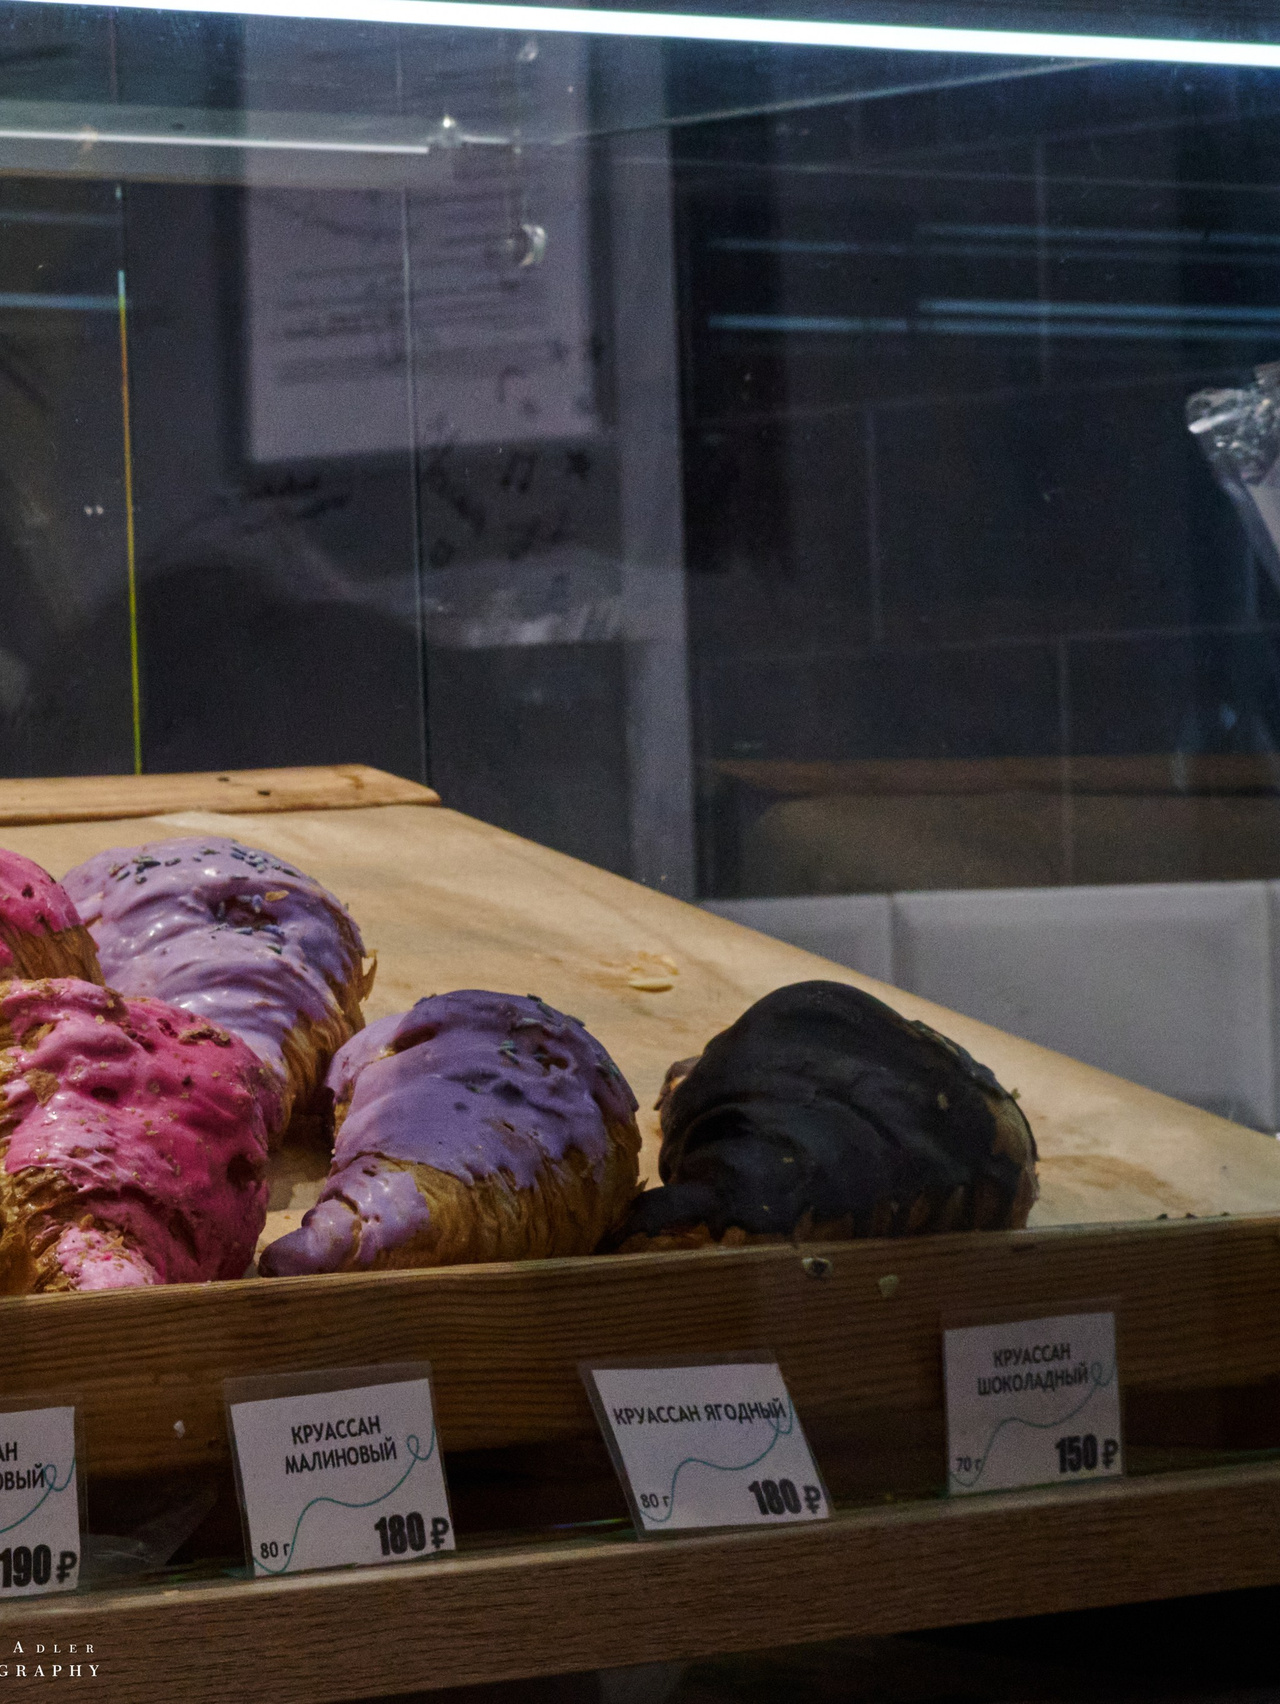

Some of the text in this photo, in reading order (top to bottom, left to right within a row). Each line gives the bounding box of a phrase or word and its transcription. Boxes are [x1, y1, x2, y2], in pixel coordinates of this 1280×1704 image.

[992, 1343, 1071, 1368] КРУАССАН
[977, 1362, 1089, 1397] ШОКОЛАДНЫЙ
[613, 1397, 787, 1426] КРУАССАН ЯГОДНЫЙ
[291, 1415, 382, 1445] КРУАССАН
[284, 1439, 397, 1475] МАЛИНОВЫЙ
[955, 1456, 972, 1472] 70
[1055, 1434, 1099, 1474] 150
[640, 1493, 659, 1509] 80
[748, 1478, 801, 1516] 180
[374, 1511, 425, 1555] 180
[259, 1541, 280, 1560] 80
